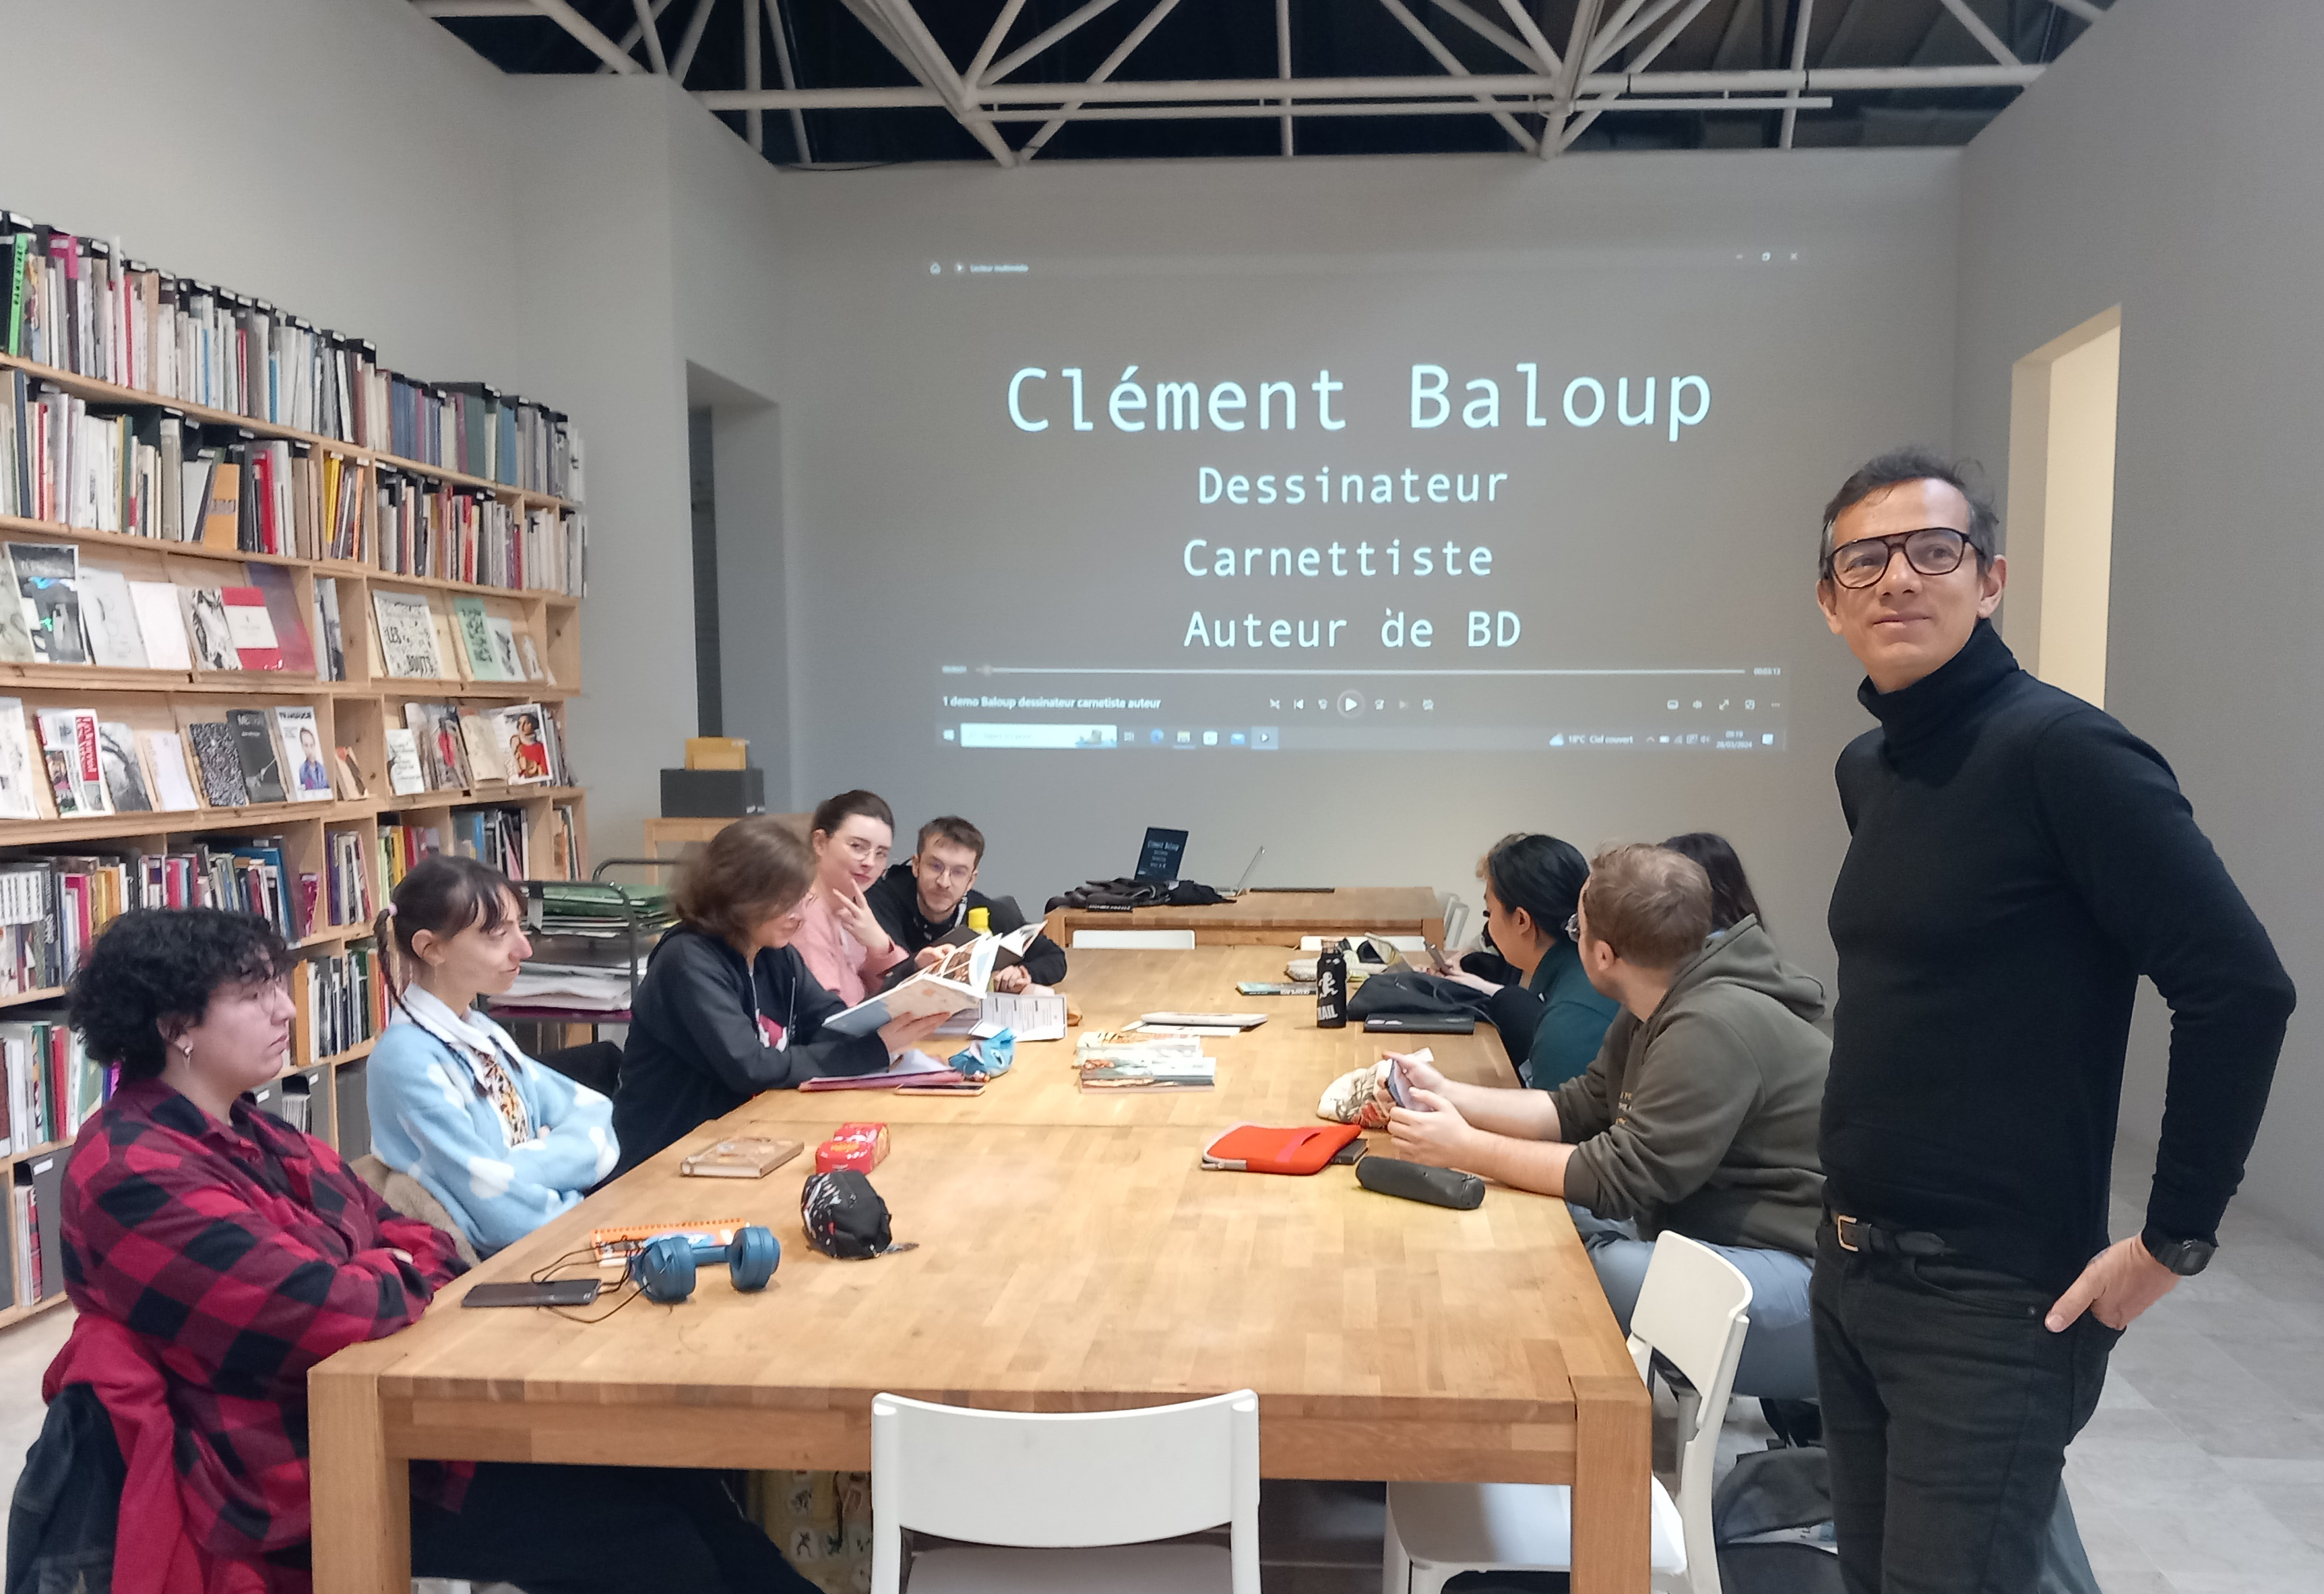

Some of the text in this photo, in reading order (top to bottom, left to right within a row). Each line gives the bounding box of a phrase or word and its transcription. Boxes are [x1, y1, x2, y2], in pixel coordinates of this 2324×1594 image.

[1008, 362, 1711, 442] Clément Baloup
[1199, 466, 1508, 505] Dessinateur
[1183, 539, 1493, 577] Carnettiste
[1183, 610, 1521, 648] Auteur de BD
[950, 696, 979, 707] demo
[980, 696, 1017, 710] Baloup
[1018, 696, 1076, 708] dessinateur
[1127, 698, 1161, 708] auteur
